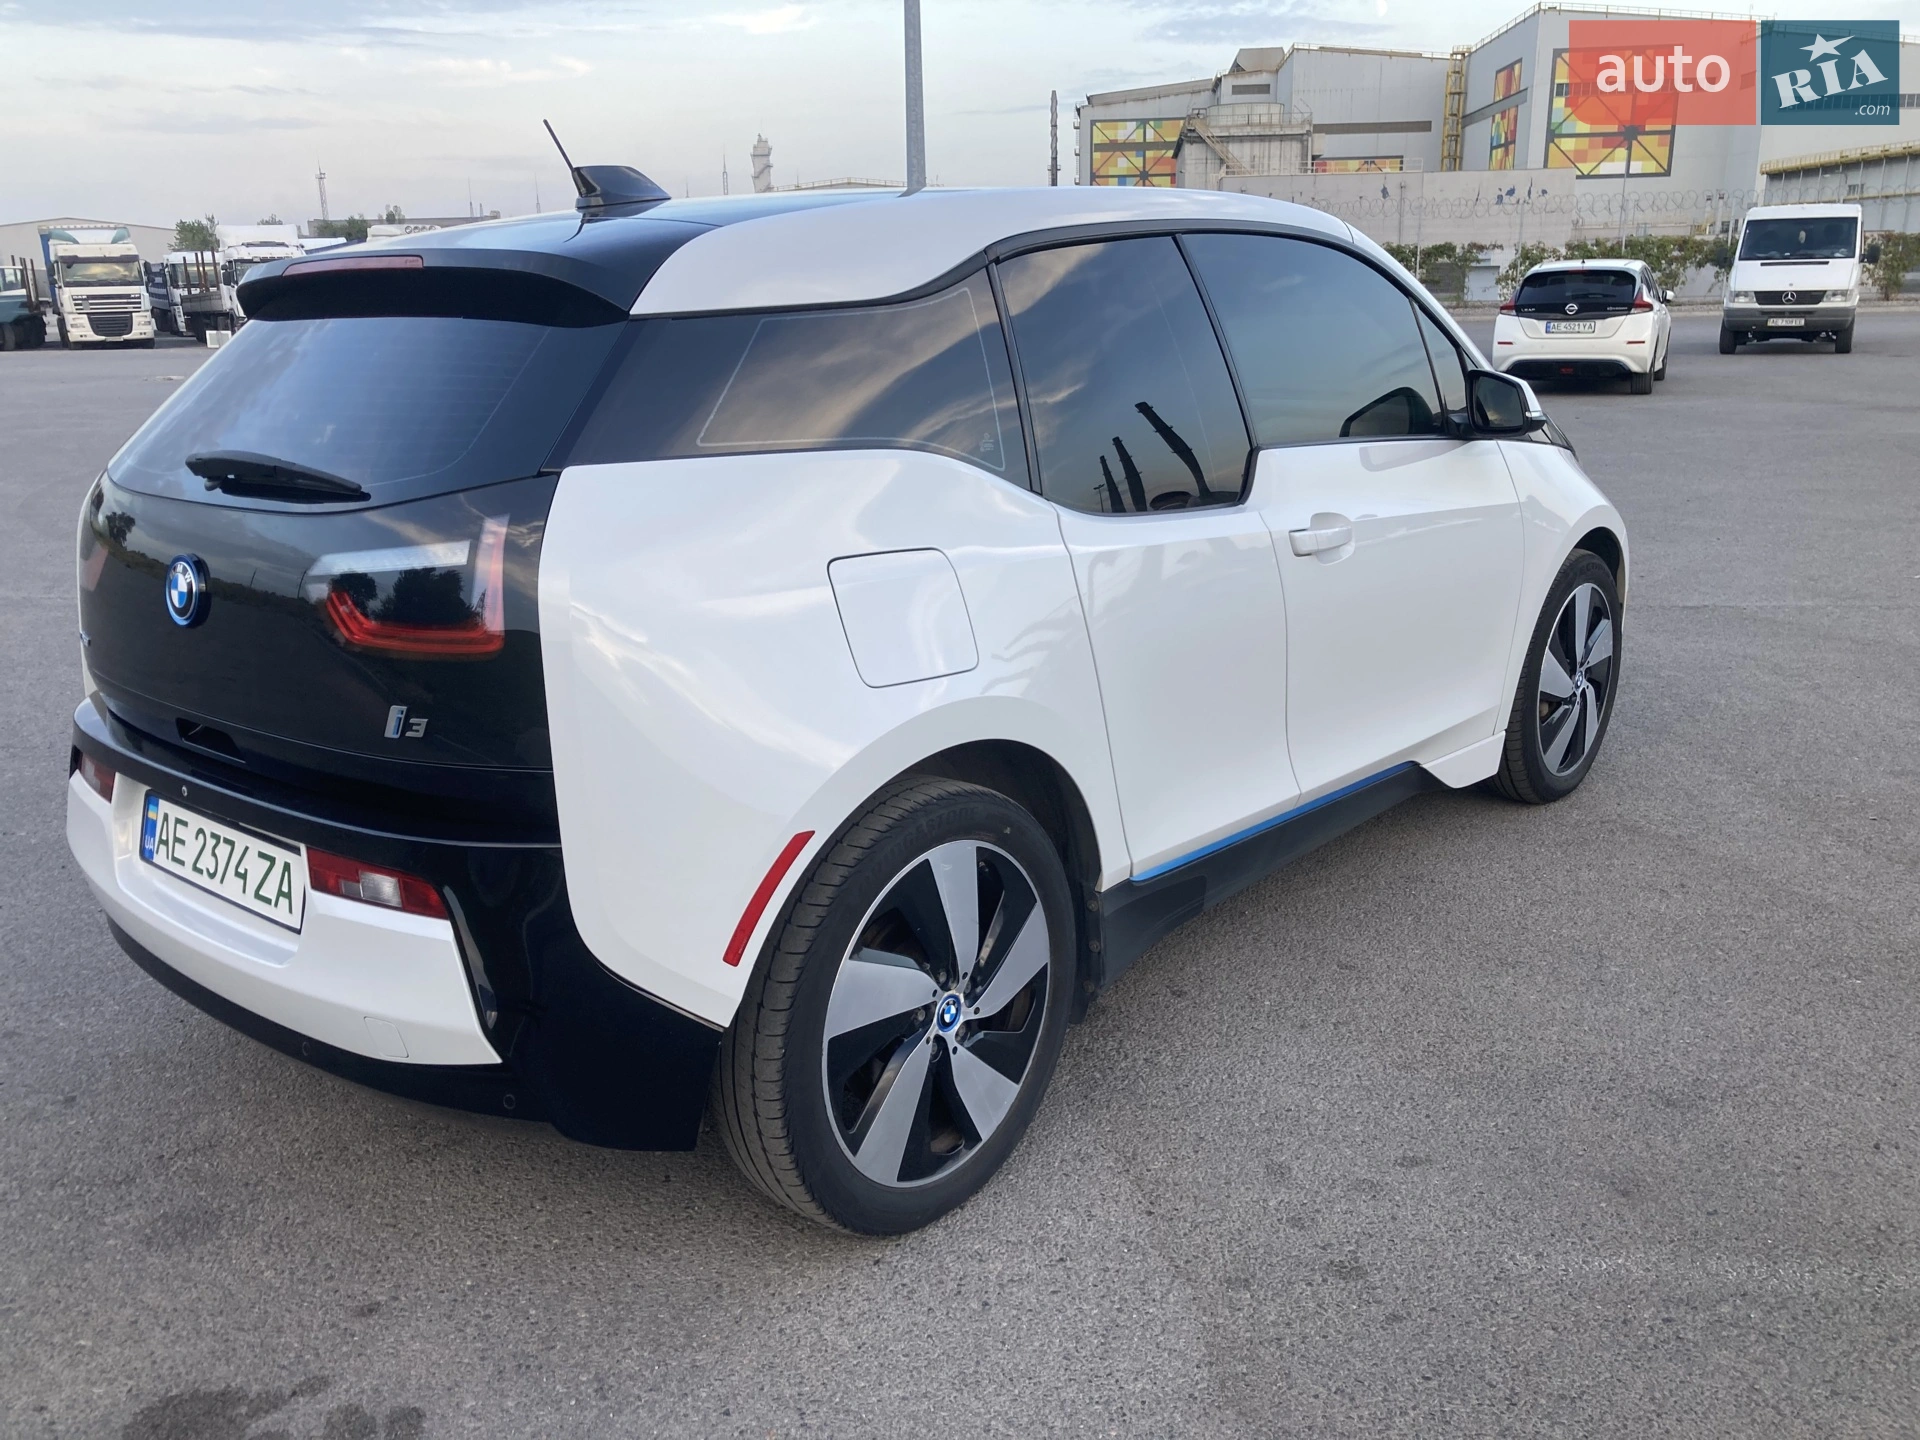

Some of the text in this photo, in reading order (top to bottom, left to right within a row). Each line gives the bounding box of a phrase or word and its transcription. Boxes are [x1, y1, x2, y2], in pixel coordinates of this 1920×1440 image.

[1551, 323, 1561, 331] AE
[1563, 323, 1581, 331] 4521
[1582, 323, 1593, 331] YA
[384, 705, 429, 738] i3
[145, 834, 154, 851] UA
[858, 806, 980, 891] DGESTONE
[155, 811, 293, 915] AE 2374 ZA
